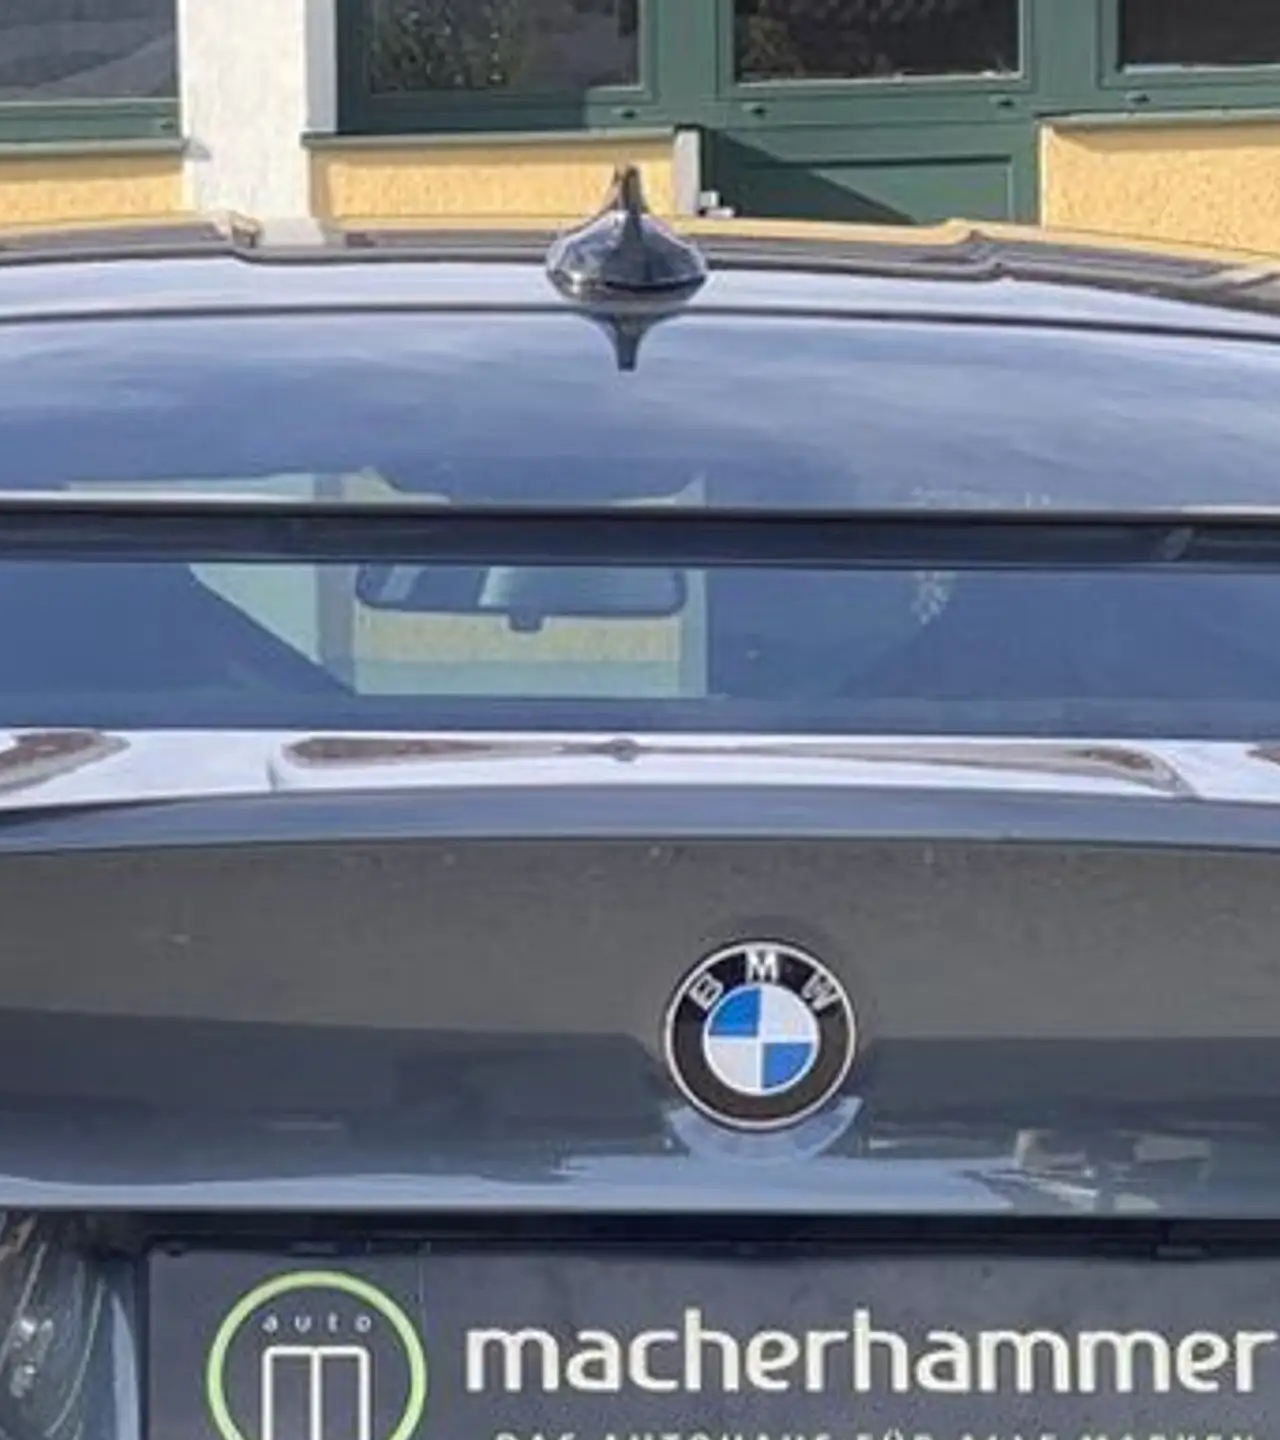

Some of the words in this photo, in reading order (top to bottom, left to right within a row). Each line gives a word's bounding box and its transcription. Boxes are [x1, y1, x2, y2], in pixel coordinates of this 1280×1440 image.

[688, 950, 843, 1011] BMW
[261, 1312, 372, 1333] auto
[465, 1308, 1279, 1392] macherhammer
